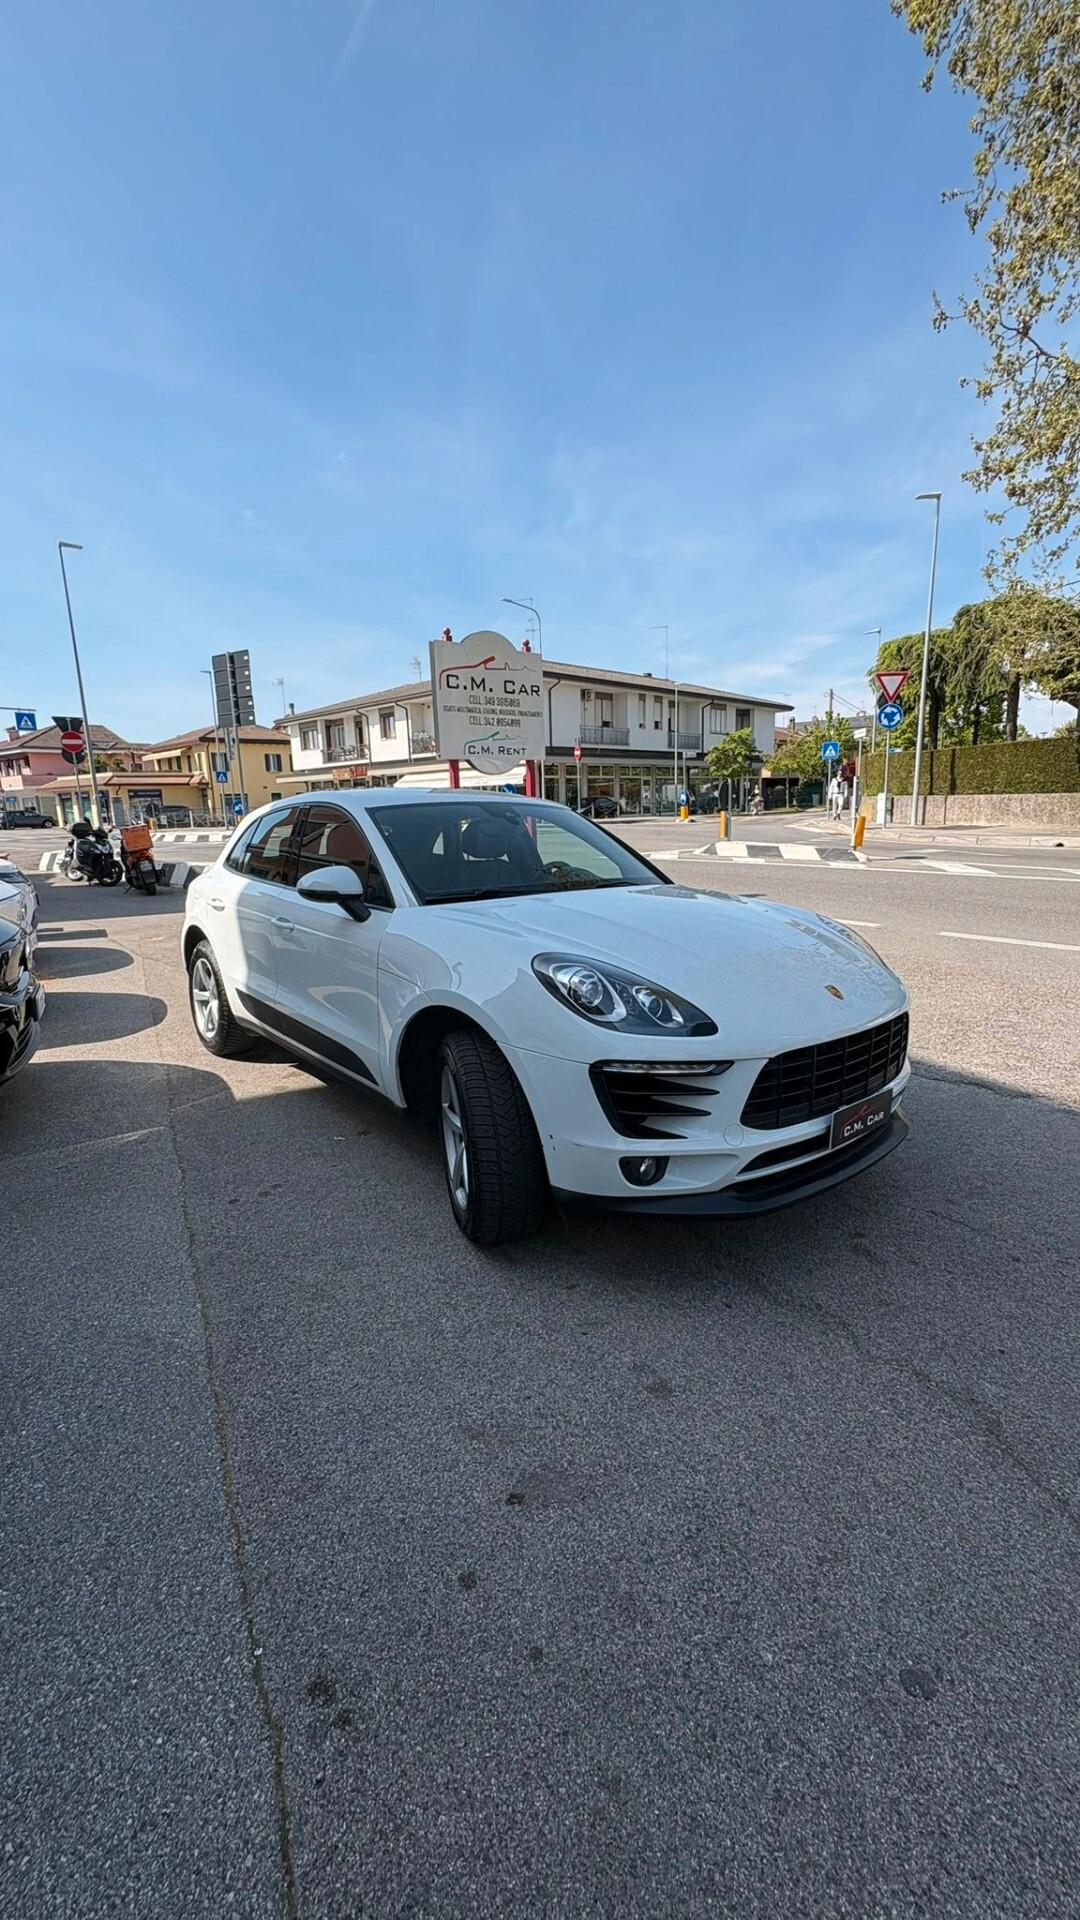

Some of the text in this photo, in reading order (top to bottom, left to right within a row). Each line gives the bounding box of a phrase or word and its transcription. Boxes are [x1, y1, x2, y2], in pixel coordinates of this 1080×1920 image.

[446, 674, 540, 697] C.M. CAR
[469, 695, 482, 705] CELL
[469, 715, 482, 726] CELL
[483, 716, 495, 727] 342
[468, 745, 527, 755] C.M. RENT
[844, 1111, 885, 1137] C.M. CAR
